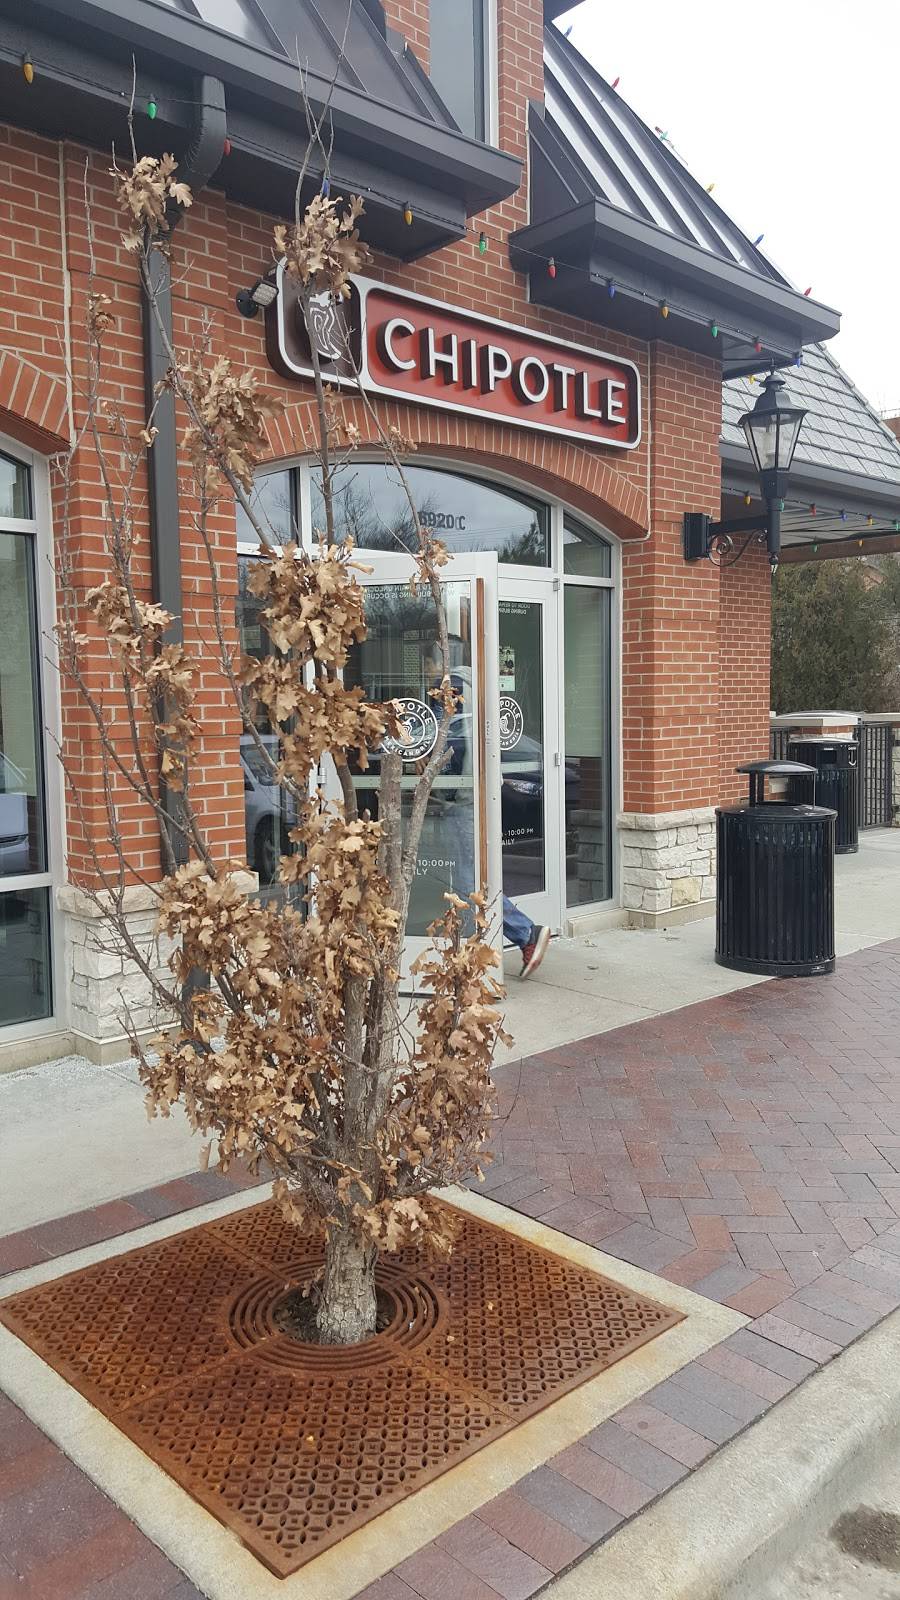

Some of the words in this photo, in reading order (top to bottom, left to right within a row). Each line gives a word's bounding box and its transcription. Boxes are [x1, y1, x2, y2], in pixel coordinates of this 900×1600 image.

[379, 317, 627, 424] CHIPOTLE
[508, 828, 525, 837] 10:00
[501, 838, 515, 846] AILY
[416, 859, 444, 867] 10:00
